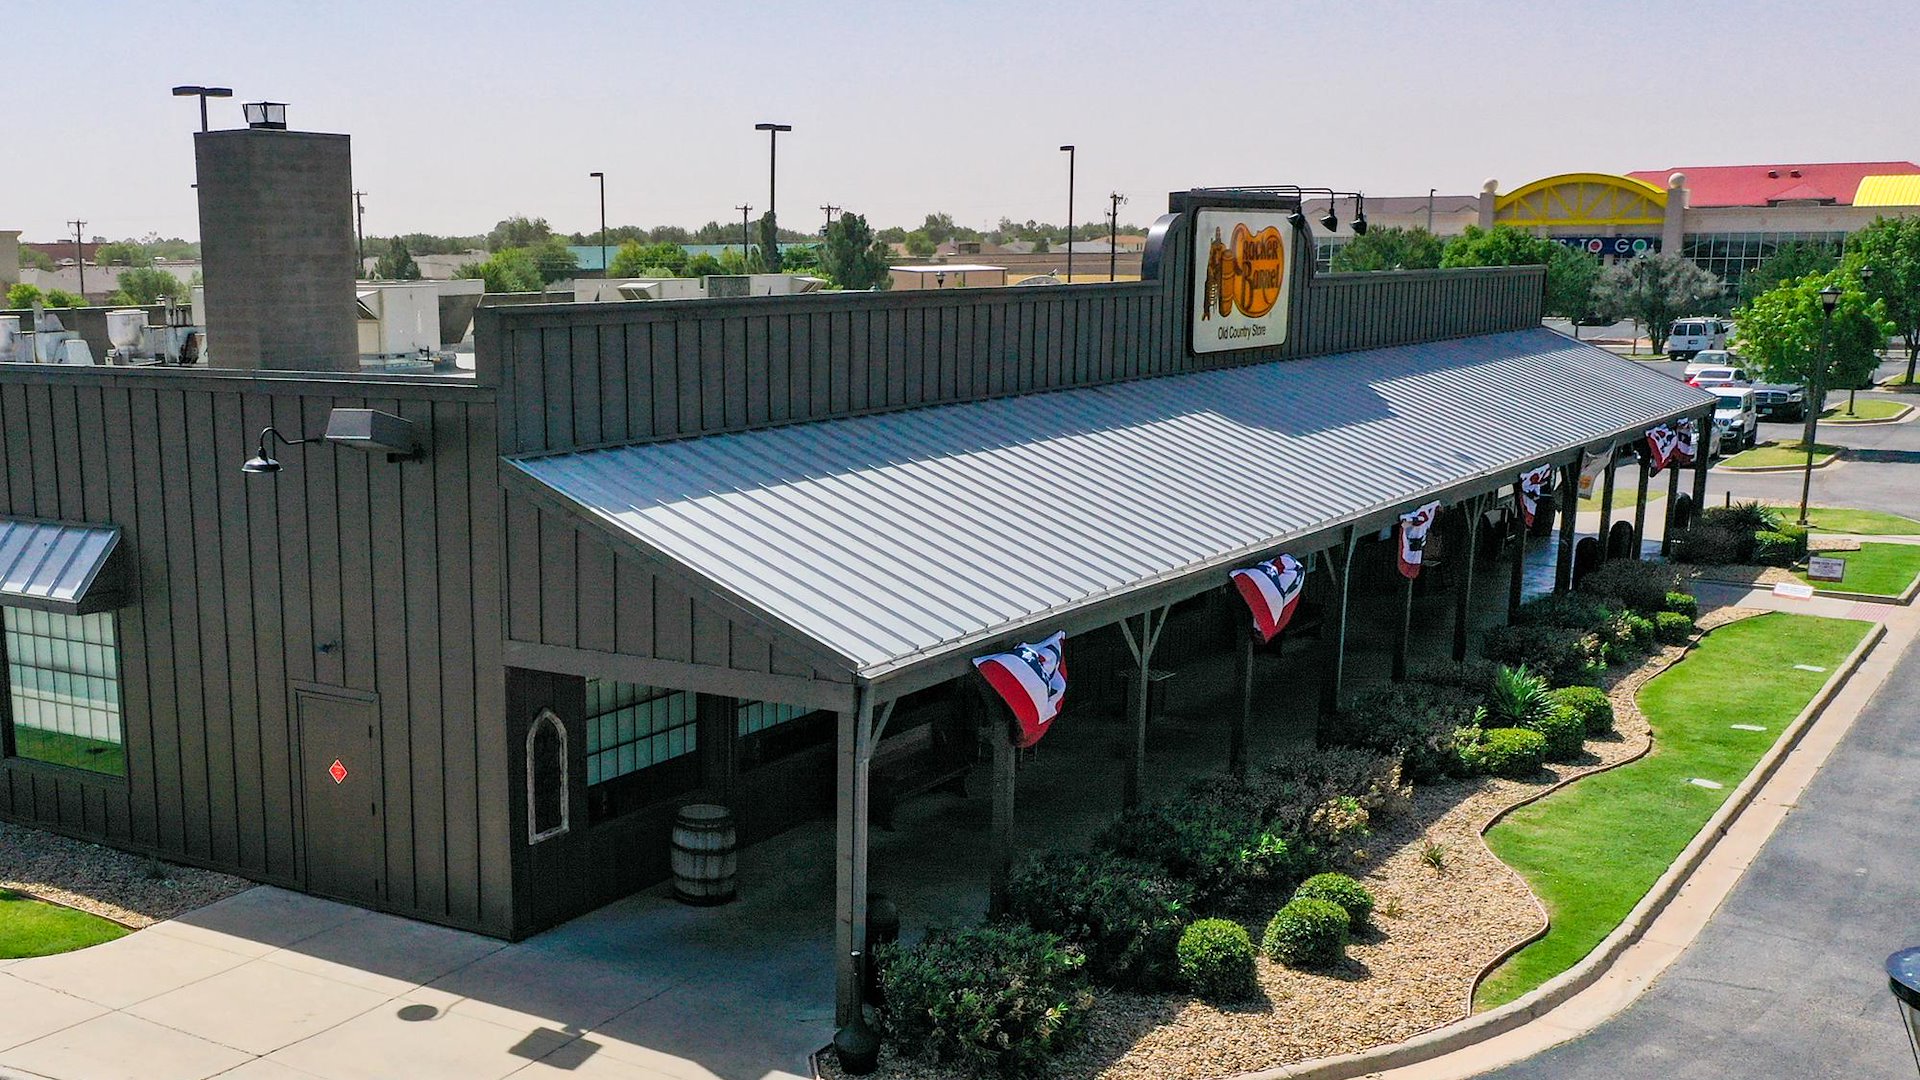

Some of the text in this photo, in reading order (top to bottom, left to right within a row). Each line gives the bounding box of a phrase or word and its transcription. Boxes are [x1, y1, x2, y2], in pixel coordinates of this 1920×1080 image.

[1580, 239, 1603, 253] TO
[1615, 239, 1648, 253] GO
[1218, 324, 1266, 341] Old Country Store
